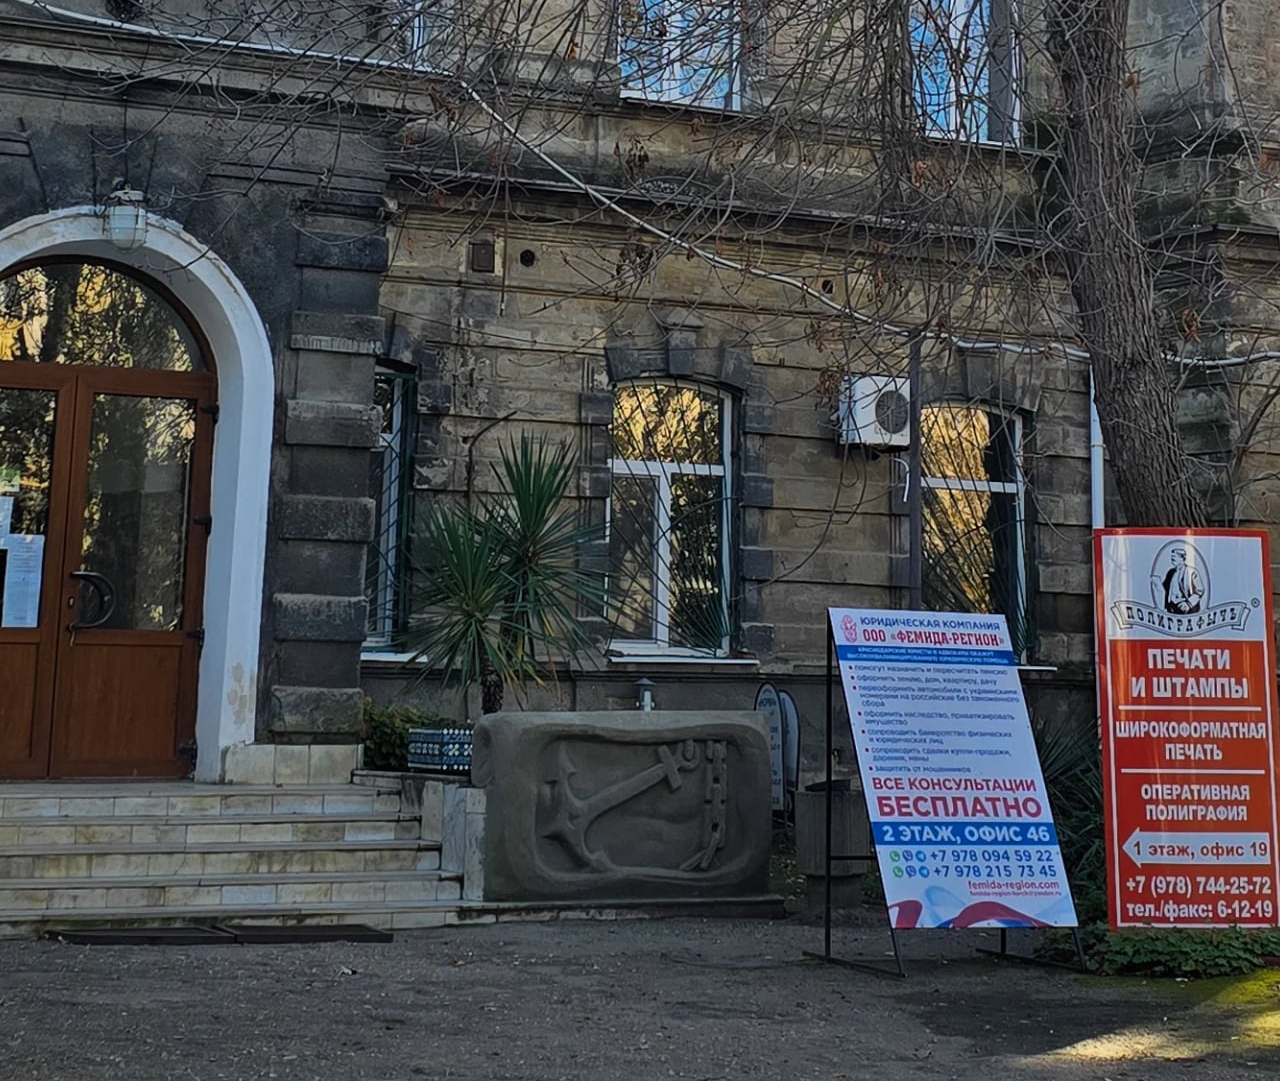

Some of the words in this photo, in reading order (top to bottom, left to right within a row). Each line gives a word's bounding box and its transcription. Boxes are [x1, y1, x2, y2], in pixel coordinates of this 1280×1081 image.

[860, 617, 939, 627] ЮРИДИЧЕСКАЯ
[942, 619, 1000, 630] КОМПАНИЯ
[1126, 606, 1237, 632] ПОЛИГРАФЫЧЪ
[863, 629, 886, 642] ООО
[891, 631, 1004, 646] «ФЕМИДА-РЕГИОН»
[1148, 649, 1230, 669] ПЕЧАТИ
[1132, 677, 1145, 697] И
[1153, 677, 1248, 698] ШТАМПЫ
[1116, 721, 1266, 738] ШИРОКОФОРМАТНАЯ
[1165, 743, 1222, 760] ПЕЧАТЬ
[873, 778, 904, 790] ВСЕ
[908, 778, 1036, 794] КОНСУЛЬТАЦИИ
[1142, 785, 1250, 800] ОПЕРАТИВНАЯ
[877, 796, 1041, 817] БЕСПЛАТНО
[1146, 805, 1247, 820] ПОЛИГРАФИЯ
[883, 826, 895, 841] 2
[899, 826, 961, 844] ЭТАЖ,
[965, 826, 1022, 842] ОФИС
[1027, 826, 1050, 841] 46
[931, 850, 946, 861] +7
[951, 850, 978, 862] 978
[982, 850, 1010, 862] 094
[1015, 850, 1032, 862] 59
[1036, 850, 1053, 862] 22
[1134, 841, 1141, 855] 1
[1148, 844, 1194, 859] этаж,
[1201, 842, 1244, 859] офис
[1251, 842, 1267, 856] 19
[934, 866, 949, 877] +7
[955, 866, 981, 878] 978
[985, 866, 1012, 878] 215
[1019, 866, 1034, 878] 73
[1039, 866, 1056, 878] 45
[968, 880, 1059, 891] femida-region.com
[1127, 876, 1145, 893] +7
[1151, 876, 1191, 897] (978)
[1197, 877, 1271, 894] 744-25-72
[1127, 901, 1212, 921] тел./факс:
[1218, 901, 1272, 917] 6-12-19
